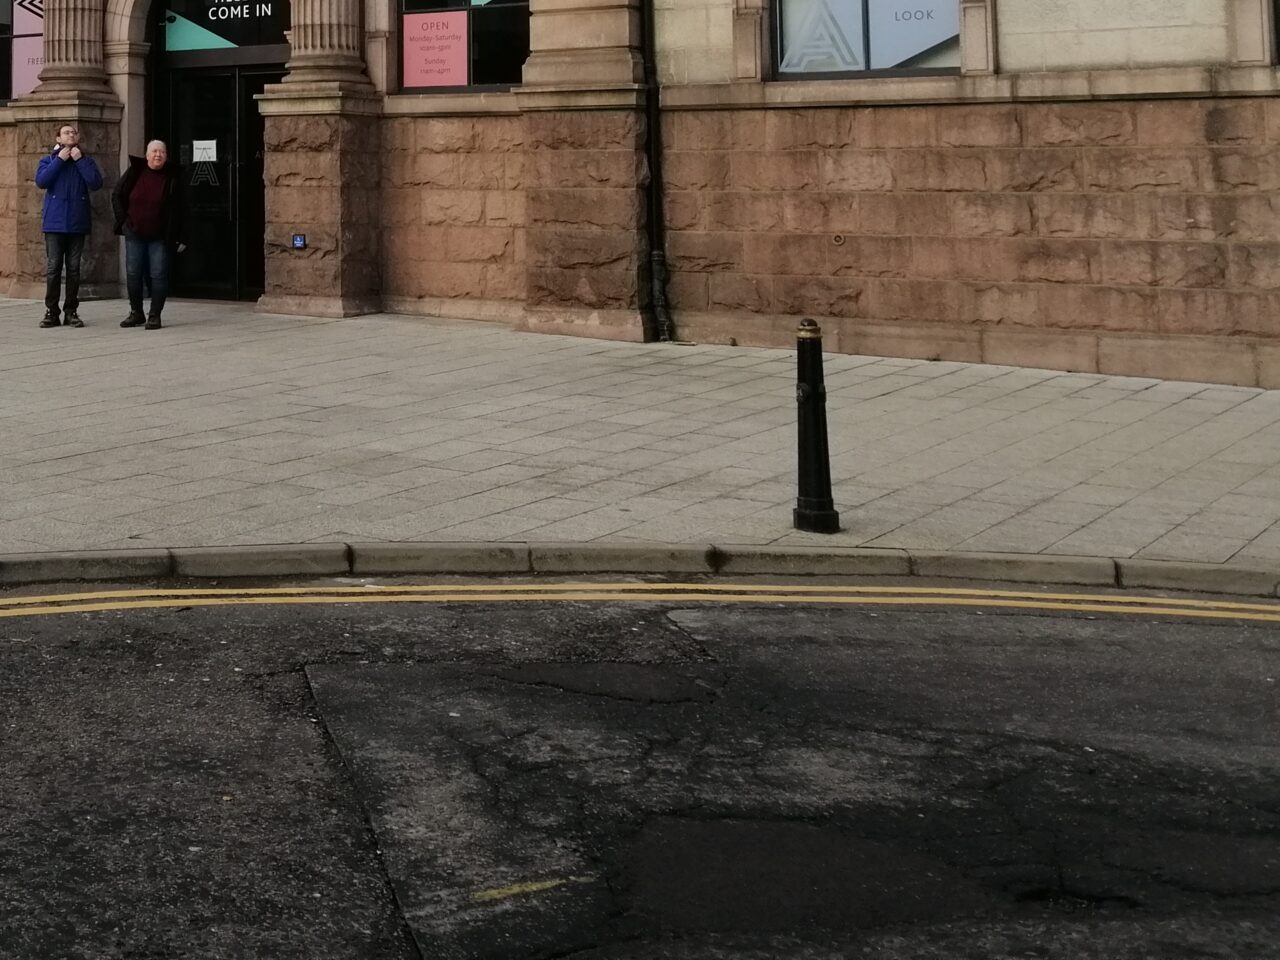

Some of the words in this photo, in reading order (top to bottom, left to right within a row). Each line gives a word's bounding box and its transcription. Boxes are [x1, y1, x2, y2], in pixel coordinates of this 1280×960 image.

[208, 5, 250, 20] COME
[256, 3, 272, 16] IN
[894, 9, 935, 21] LOOK
[421, 21, 448, 31] OPEN
